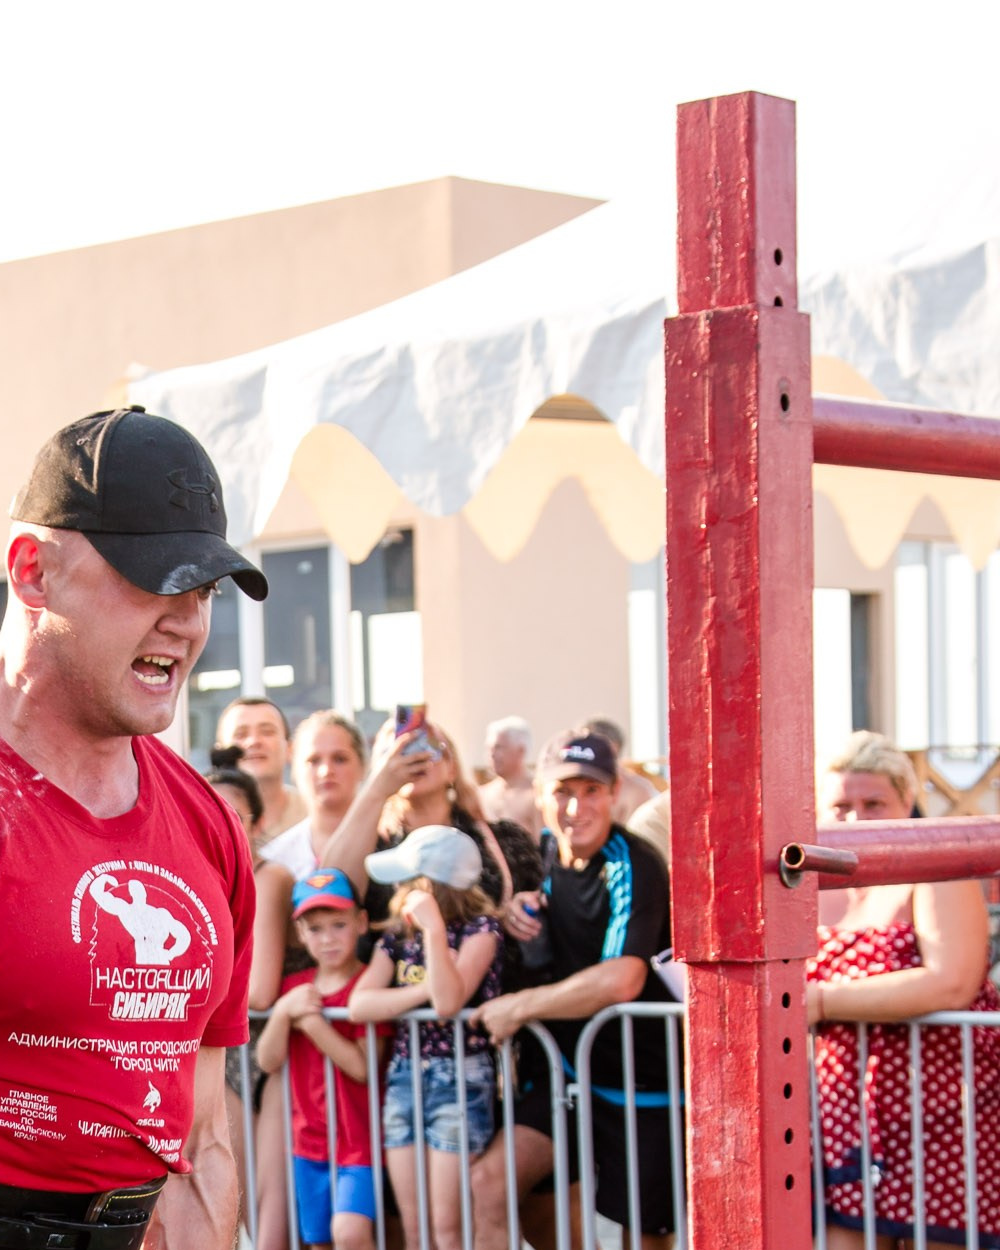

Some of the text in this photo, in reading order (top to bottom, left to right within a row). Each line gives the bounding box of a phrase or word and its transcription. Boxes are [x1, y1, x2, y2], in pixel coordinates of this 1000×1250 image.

[96, 964, 211, 991] НАСТОЯЩИЙ
[111, 991, 191, 1019] СИБИРЯК
[8, 1031, 199, 1057] АДМИНИСТРАЦИЯ ГОРОДСКОГО
[0, 1096, 58, 1114] УПРАВЛЕНИЕ
[9, 1089, 49, 1104] ГЛАВНОЕ
[0, 1105, 57, 1122] МЧС РОССИИ
[20, 1116, 34, 1126] ПО
